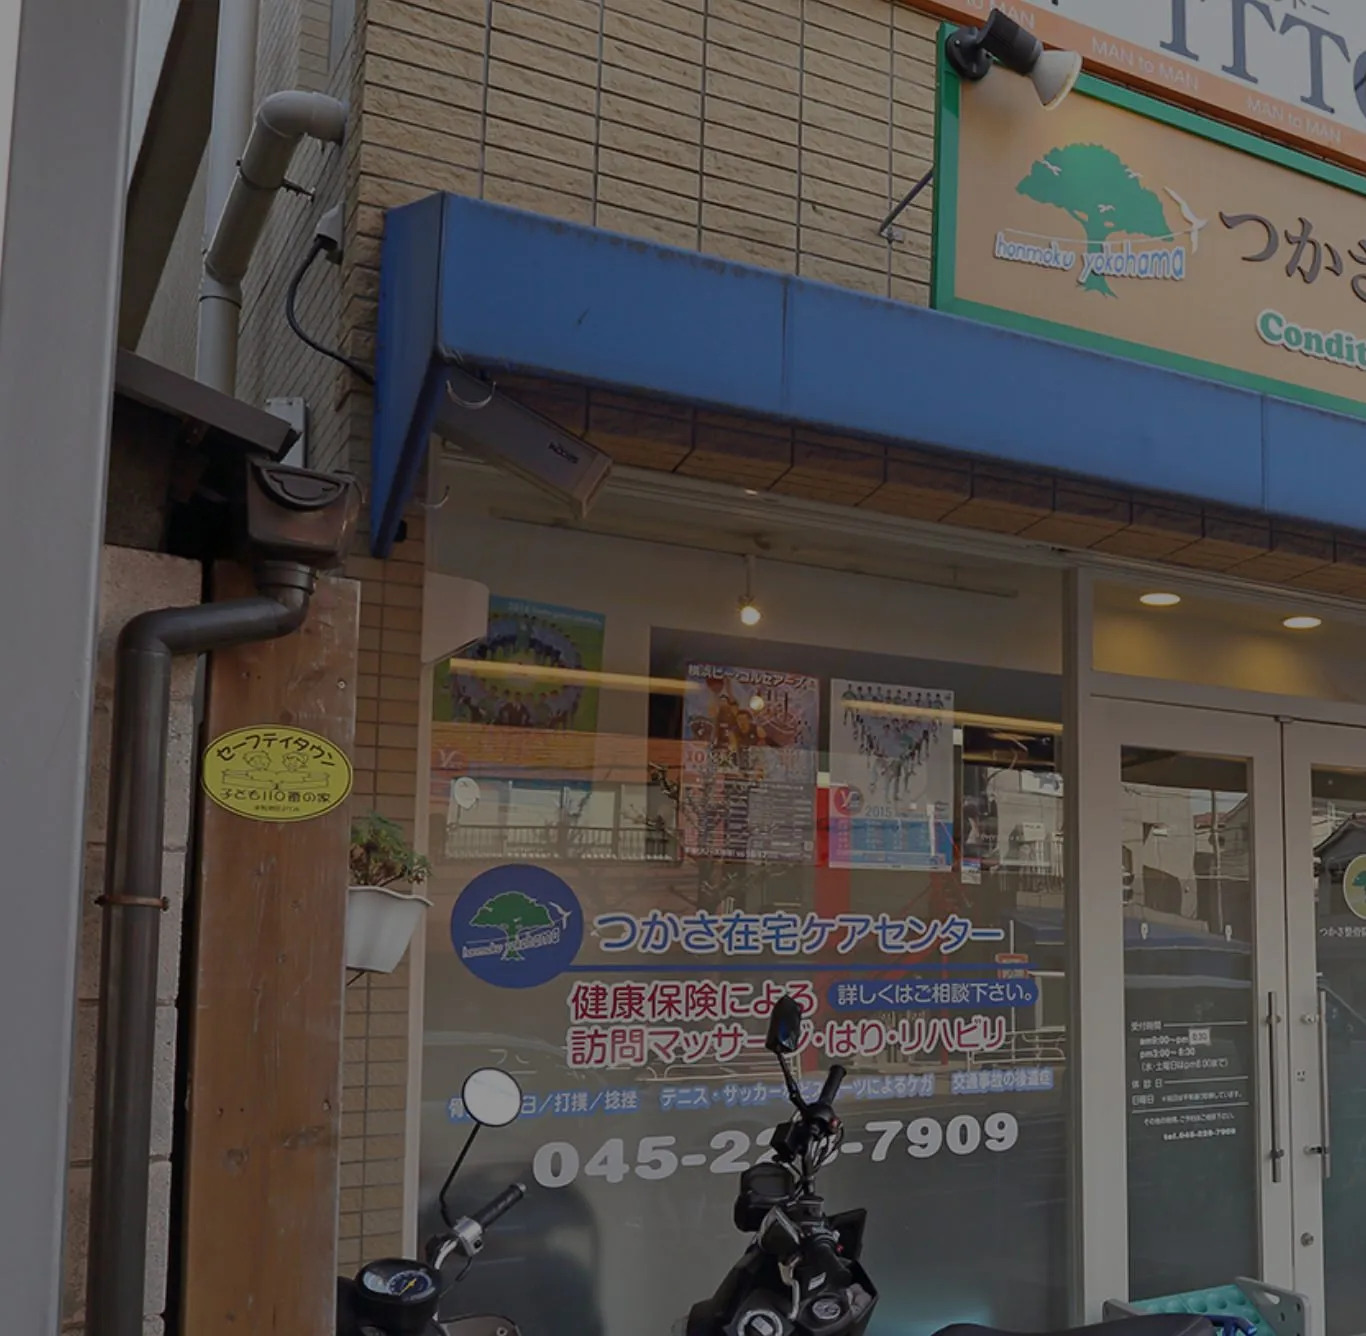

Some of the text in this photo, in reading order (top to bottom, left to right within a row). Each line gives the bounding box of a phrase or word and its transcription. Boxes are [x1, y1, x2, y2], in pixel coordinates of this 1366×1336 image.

[1092, 36, 1199, 92] MAN to MAN
[1246, 93, 1285, 123] MAN
[1304, 116, 1342, 145] MAN
[995, 232, 1186, 284] honmoku yokohama
[216, 733, 337, 767] セーフティタウン
[220, 788, 331, 804] 子ども110番の家
[865, 806, 893, 818] 2015
[596, 911, 1004, 953] つかさ在宅ケアセンター
[571, 981, 816, 1020] 健康保険による
[837, 982, 1033, 1006] 詳しくはご相談下さい。
[661, 1073, 934, 1107] テニス・サッカーどスーツによるケガ
[532, 1112, 1019, 1189] 045-22-7909
